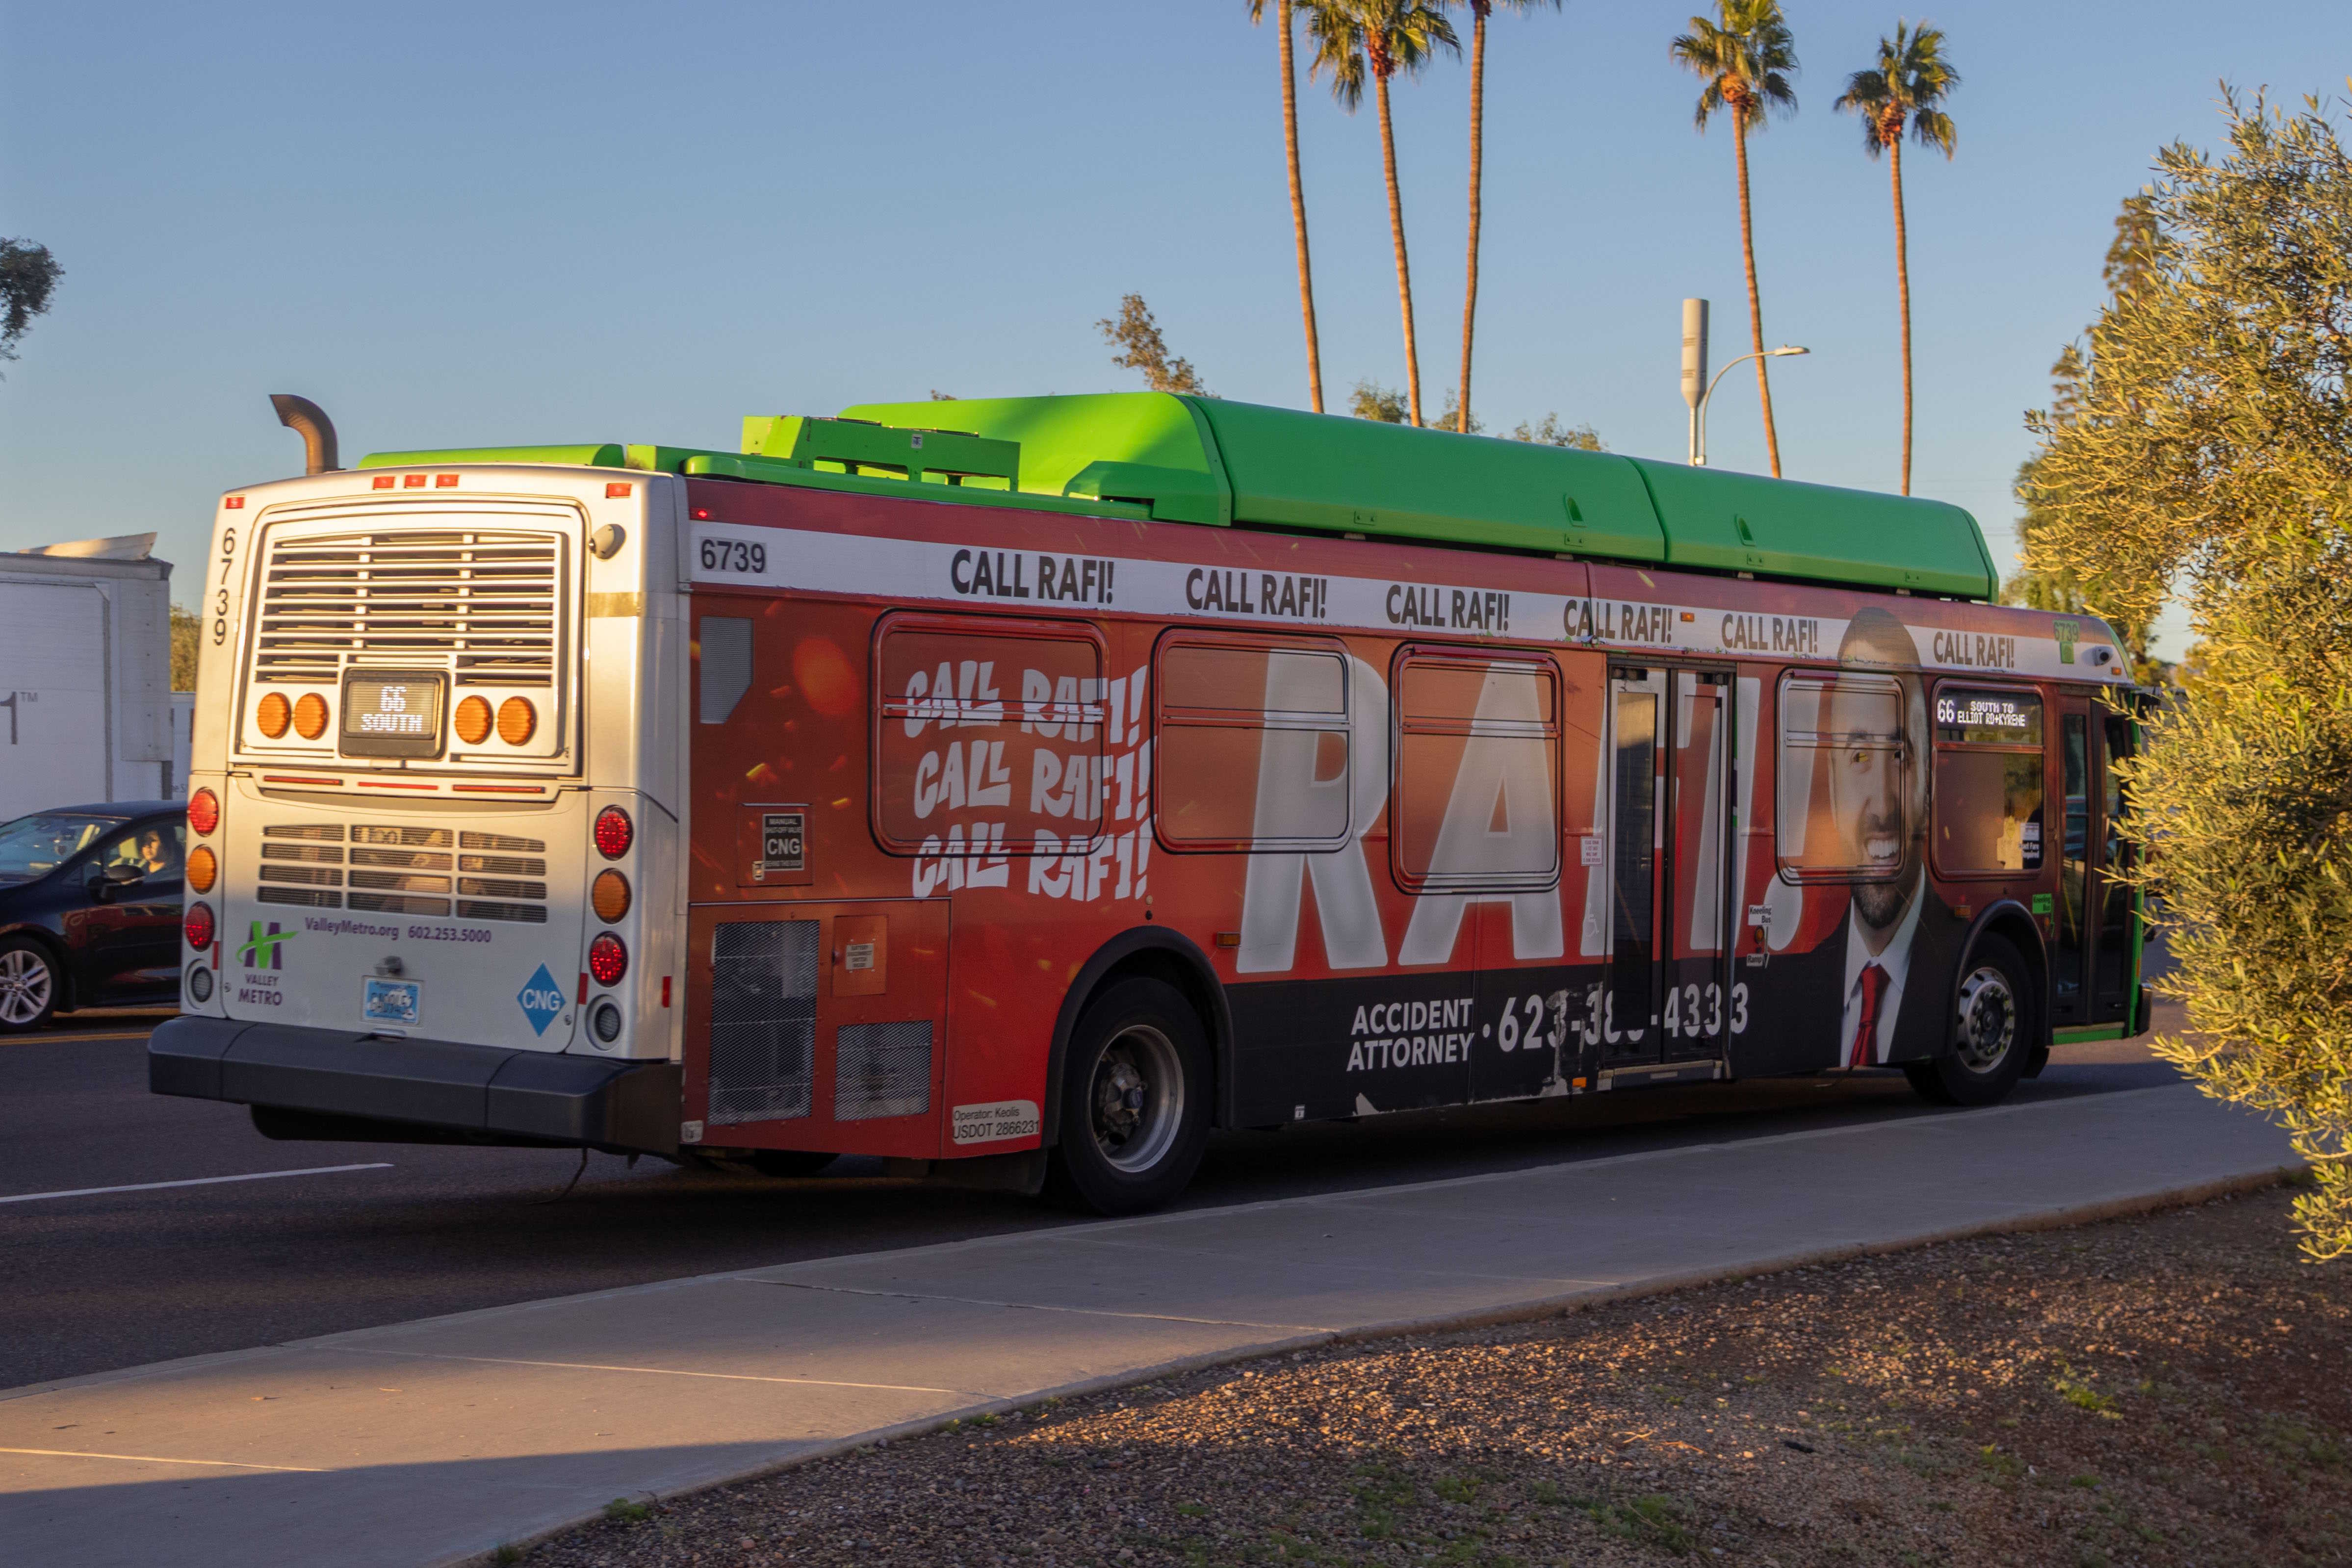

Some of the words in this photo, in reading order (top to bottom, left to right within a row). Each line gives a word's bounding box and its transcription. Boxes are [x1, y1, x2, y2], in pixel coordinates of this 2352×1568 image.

[700, 540, 766, 574] 6739
[214, 527, 235, 646] 6739
[951, 549, 1029, 598] CALL
[1038, 555, 1114, 604] RAFI!
[1186, 568, 1254, 614] CALL
[1261, 573, 1327, 618] RAFI!
[1386, 585, 1446, 626] CALL
[1451, 590, 1510, 631] RAFI!
[1563, 599, 1615, 639] CALL
[1621, 604, 1673, 643] RAFI!
[1721, 613, 1769, 650] CALL
[1772, 617, 1818, 653] RAFI!
[2054, 621, 2079, 642] 6739
[1933, 631, 1972, 665] CALL
[1976, 635, 2015, 668] RAFI!
[380, 686, 407, 711] 66
[904, 660, 1004, 738] CALL
[1937, 698, 1955, 723] 66
[1969, 700, 2000, 713] SOUTH
[2001, 702, 2014, 714] TO
[360, 714, 423, 731] SOUTH
[1957, 710, 1984, 724] ELLIOT
[914, 740, 1011, 819] CALL
[767, 838, 801, 854] CNG
[912, 822, 1011, 898] CALL
[1750, 906, 1772, 915] Kneeling
[305, 917, 399, 941] ValleyMetro.org
[409, 925, 491, 942] 602.253.5000
[1747, 955, 1762, 964] Ramp
[245, 974, 280, 986] VALLEY
[238, 988, 282, 1006] METRO
[522, 989, 560, 1011] CNG
[1351, 998, 1473, 1036] ACCIDENT
[1346, 1032, 1475, 1073] ATTORNEY
[954, 1110, 992, 1123] Operator:
[995, 1106, 1020, 1118] Keolis
[953, 1122, 993, 1139] USDOT
[995, 1120, 1039, 1136] 2866231
